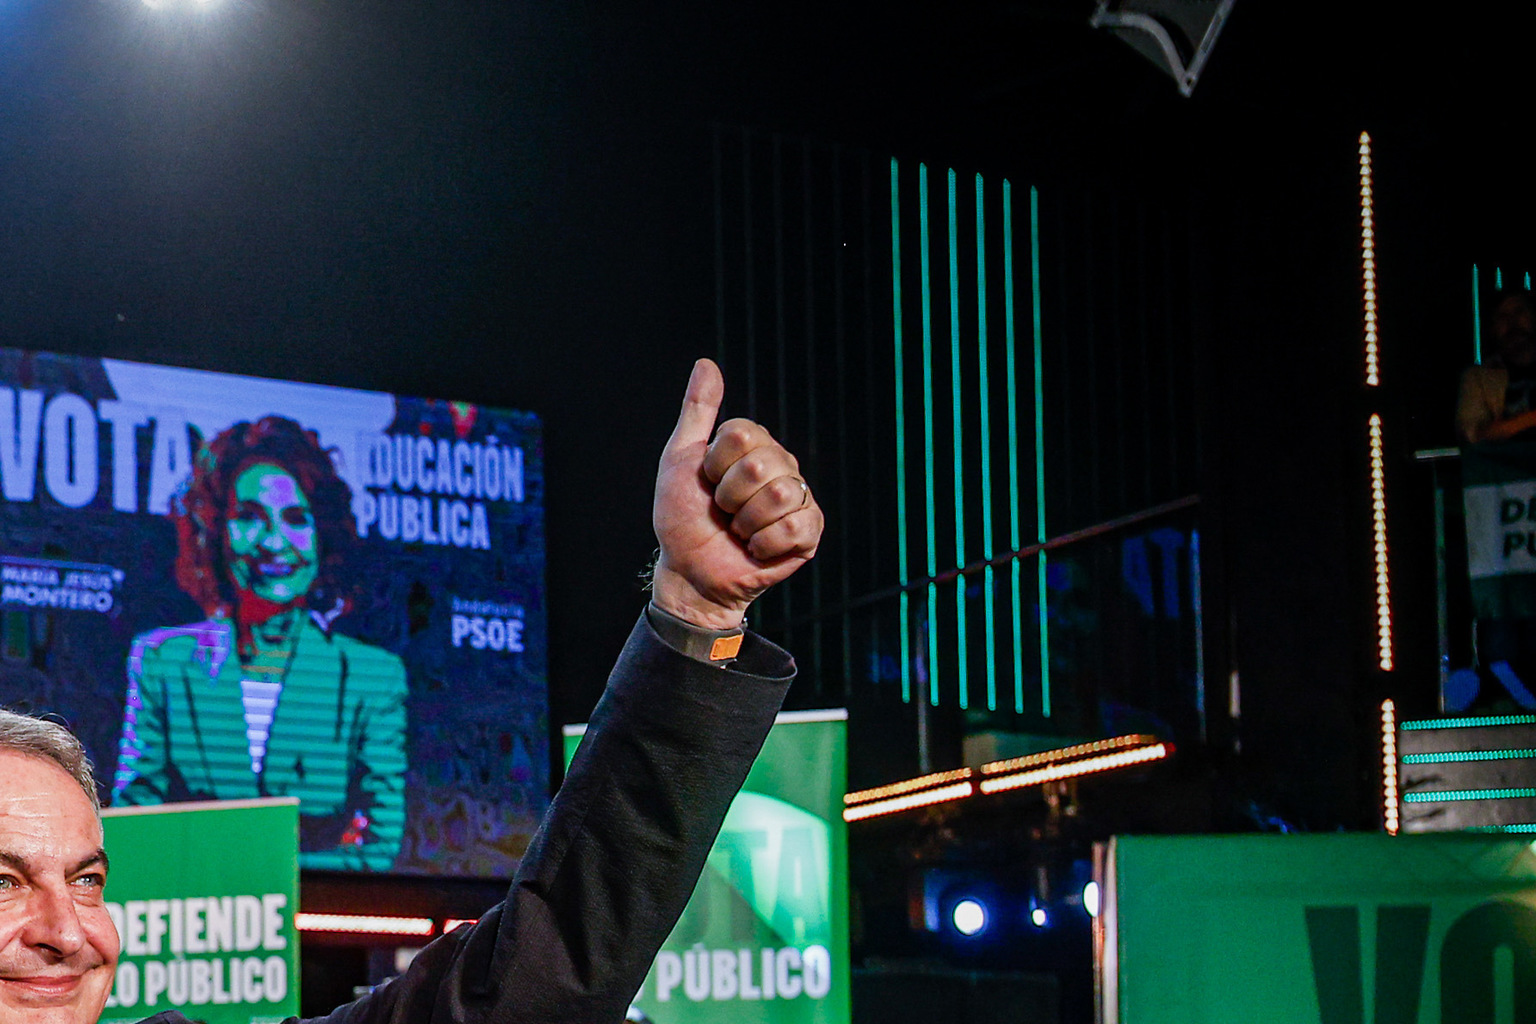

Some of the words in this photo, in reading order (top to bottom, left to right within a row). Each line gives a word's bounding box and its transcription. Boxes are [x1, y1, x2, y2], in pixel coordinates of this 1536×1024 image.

[451, 613, 525, 653] PSOE
[105, 960, 140, 1008] O
[144, 950, 288, 1007] PÚBLICO
[657, 943, 831, 1002] PÚBLICO
